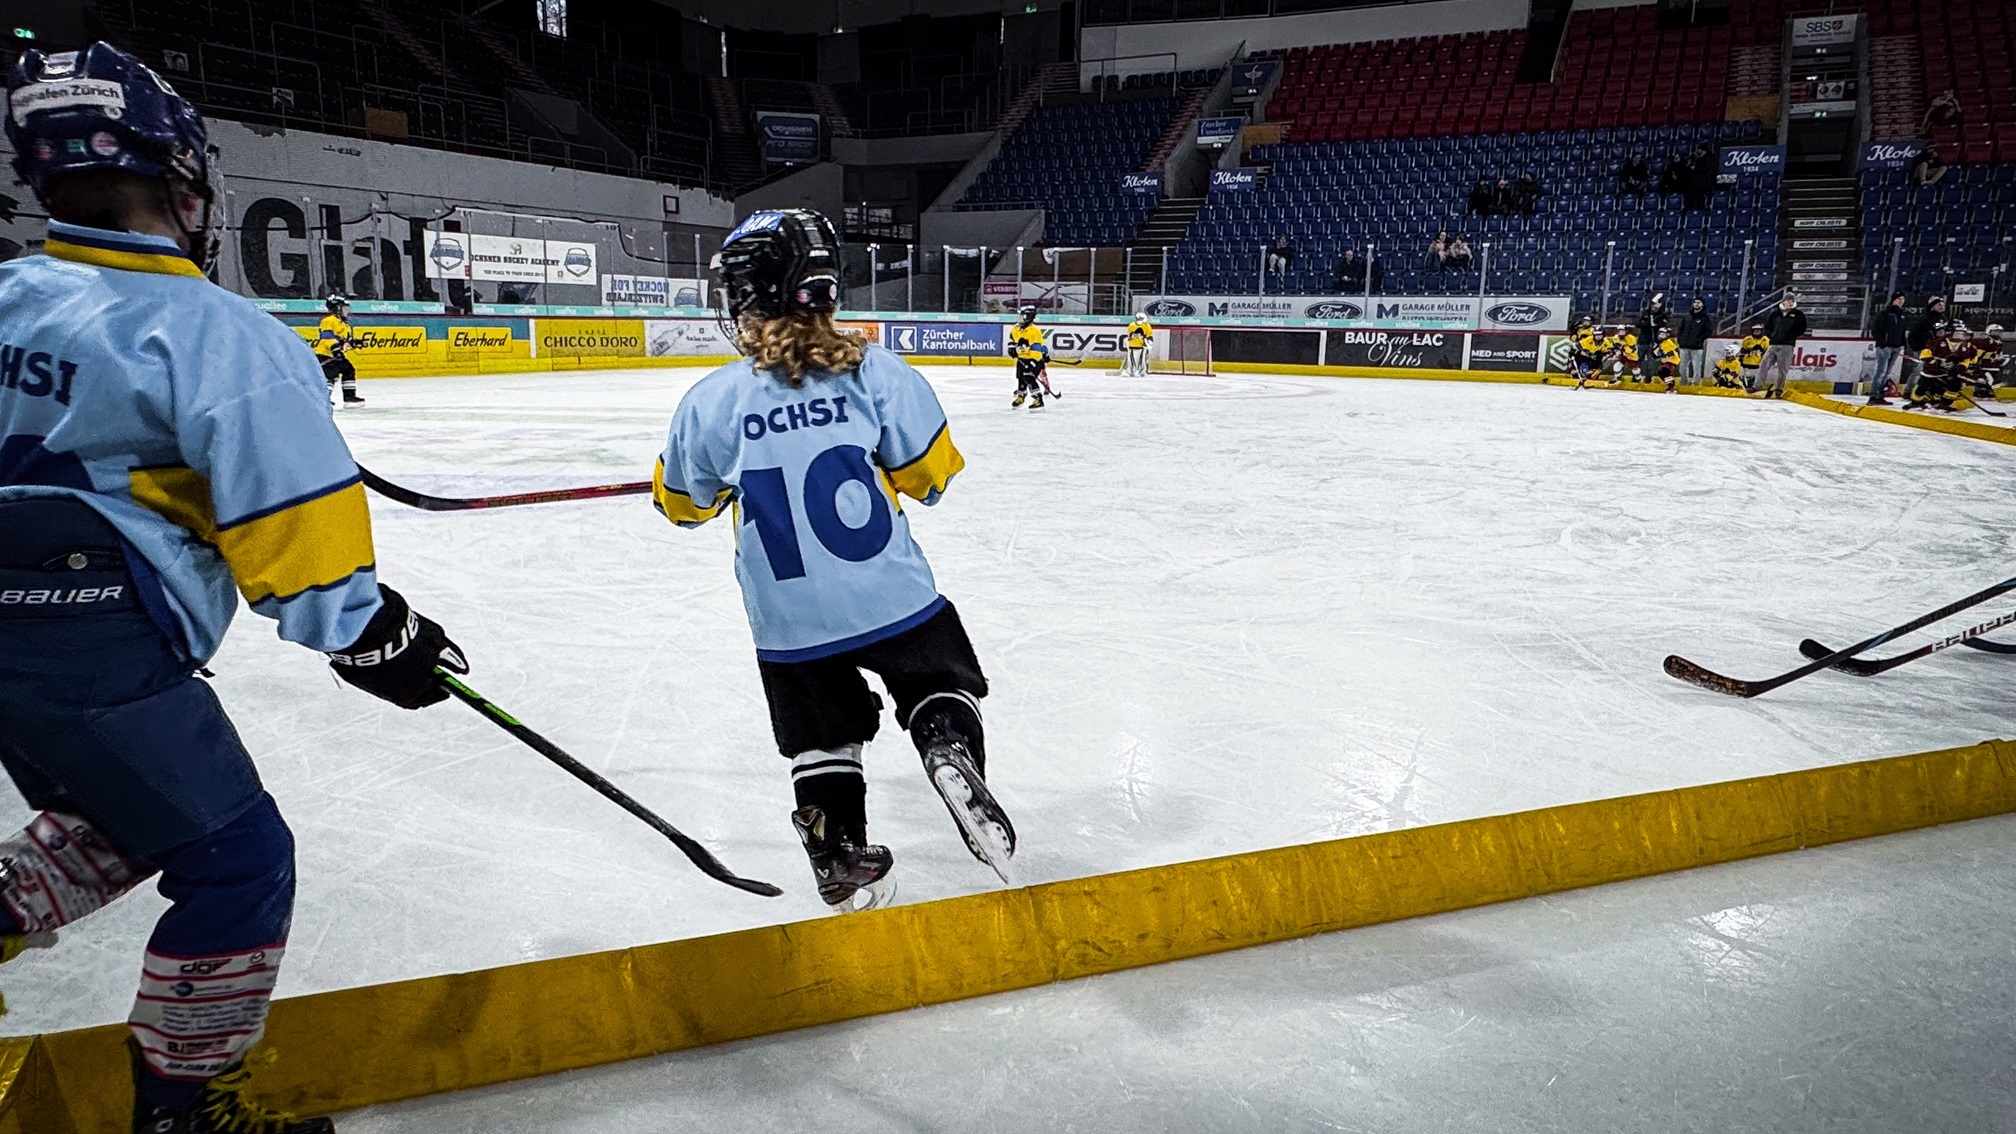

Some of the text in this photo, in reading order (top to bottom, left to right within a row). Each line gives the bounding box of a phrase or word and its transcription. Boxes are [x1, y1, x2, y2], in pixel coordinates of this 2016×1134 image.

[1805, 20, 1832, 33] SBS
[70, 84, 120, 98] Zürich
[1724, 150, 1780, 167] Kloten
[1866, 144, 1922, 161] Klote
[1121, 174, 1158, 188] Kloten
[1212, 171, 1252, 185] Kloten
[503, 255, 529, 265] HOCKEY
[1153, 302, 1188, 318] Ford
[1231, 302, 1260, 310] GARAGE
[1261, 300, 1292, 310] MÜLLER
[1314, 302, 1352, 319] Ford
[1401, 303, 1435, 311] GARAGE
[1437, 301, 1471, 312] MÜLLER
[1964, 307, 2015, 315] MONSTER
[1495, 302, 1539, 323] Ford
[361, 331, 422, 349] Eberhard
[454, 331, 509, 348] Eberhard
[922, 327, 965, 340] Zürcher
[1344, 332, 1444, 346] BAUR au LAC
[543, 336, 638, 349] CHICCO D'ORO
[922, 339, 996, 351] Kantonalbank
[1367, 341, 1424, 367] Vins
[1471, 350, 1492, 358] MED
[1505, 350, 1537, 358] SPORT
[743, 395, 849, 441] OCHSI
[739, 444, 893, 582] 10
[0, 585, 124, 604] BAUER
